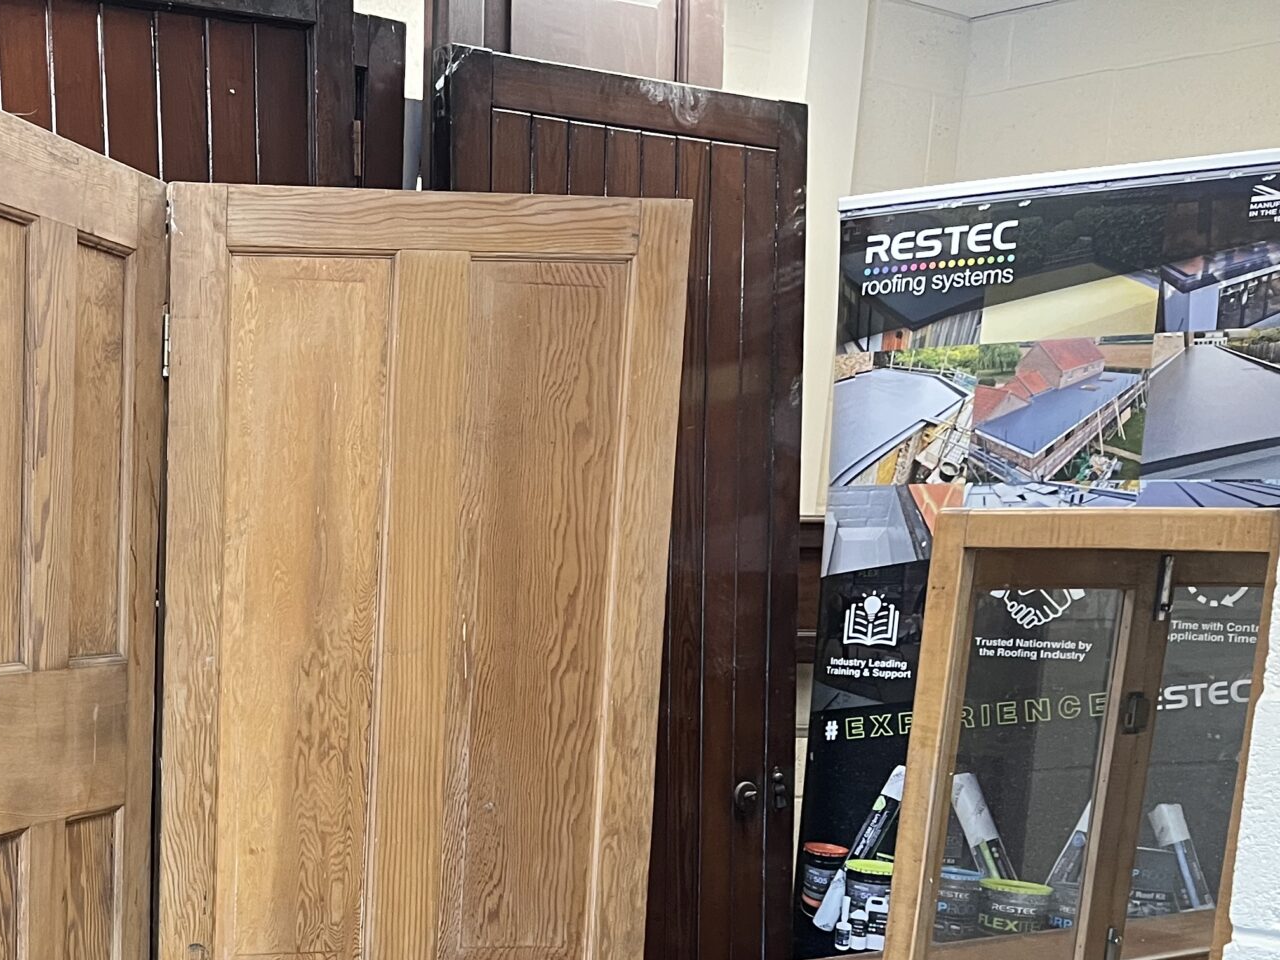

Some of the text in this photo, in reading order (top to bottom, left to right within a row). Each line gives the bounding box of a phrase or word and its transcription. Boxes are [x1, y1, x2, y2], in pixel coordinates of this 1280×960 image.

[1260, 208, 1277, 216] THE
[865, 220, 1019, 264] RESTEC
[861, 268, 1014, 296] roofing systems
[1171, 620, 1199, 630] Time
[1201, 621, 1224, 632] with
[975, 636, 1093, 652] Trusted Nationwide by
[1167, 631, 1257, 644] pplication Time
[979, 647, 1086, 662] the Roofing Industry
[830, 657, 908, 671] Industry Leading
[826, 666, 912, 679] Training & Support
[1157, 679, 1252, 710] STEC
[991, 903, 1037, 915] RESTEC
